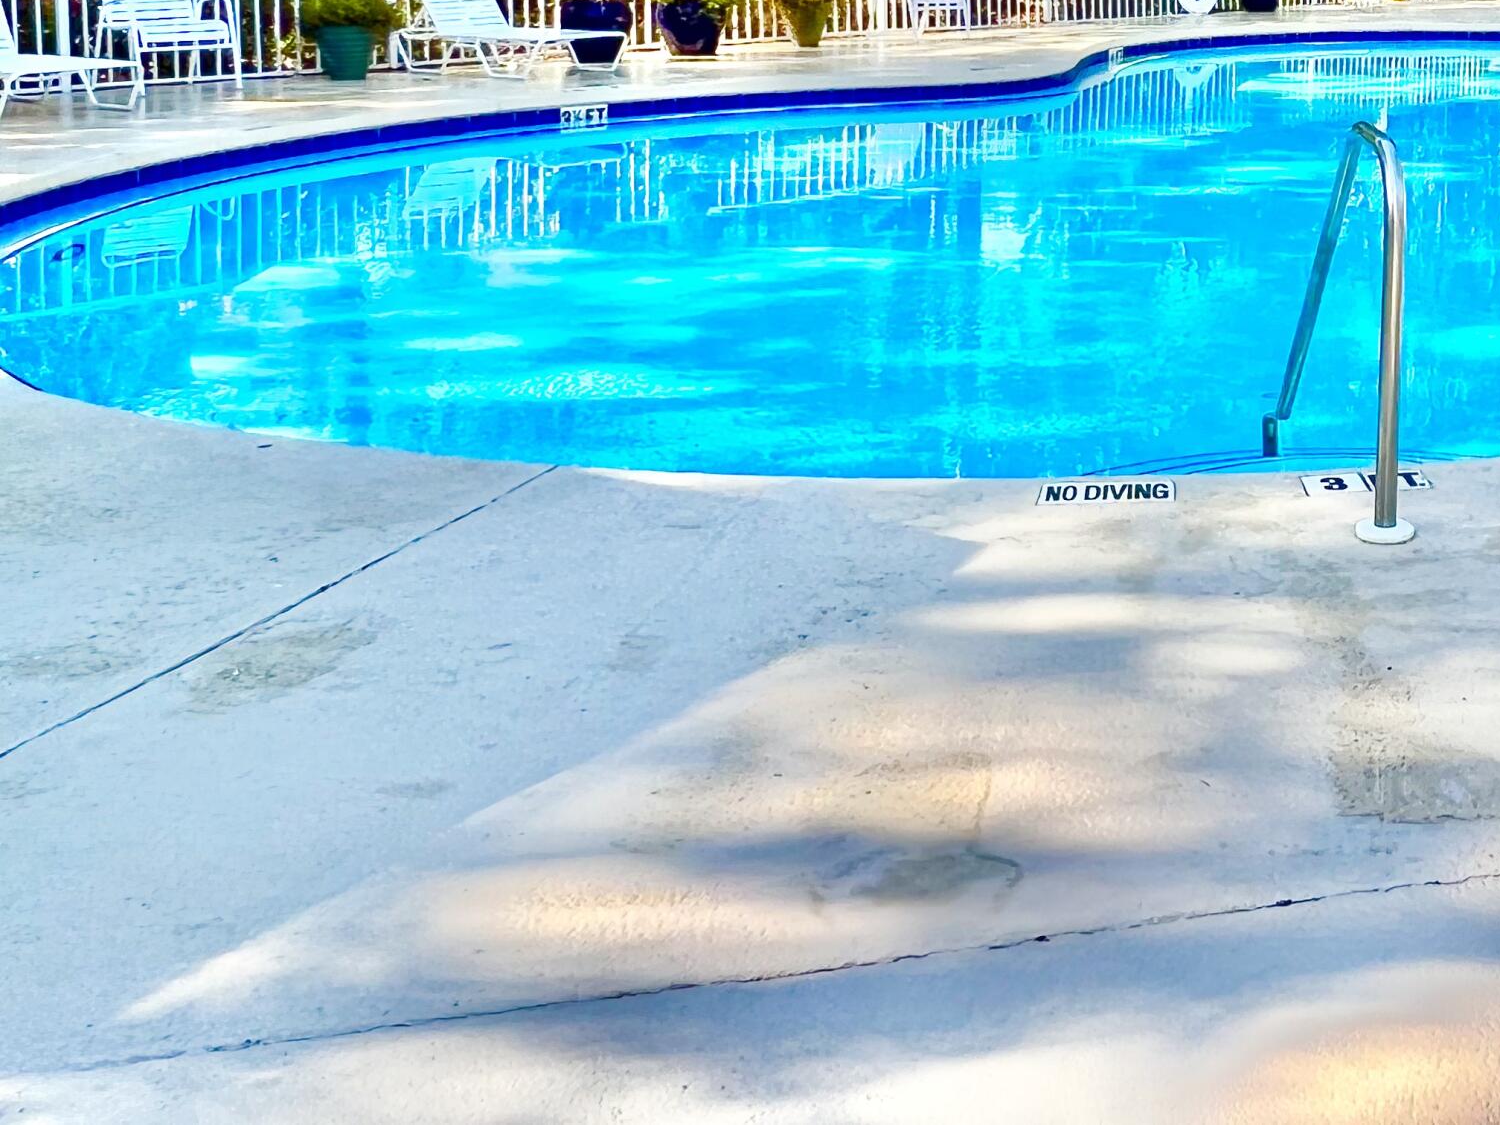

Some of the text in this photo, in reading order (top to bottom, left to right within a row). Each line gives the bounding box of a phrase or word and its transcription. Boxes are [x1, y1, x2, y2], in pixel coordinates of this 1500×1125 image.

[1319, 477, 1348, 490] 3
[1045, 483, 1169, 501] NO DIVING
